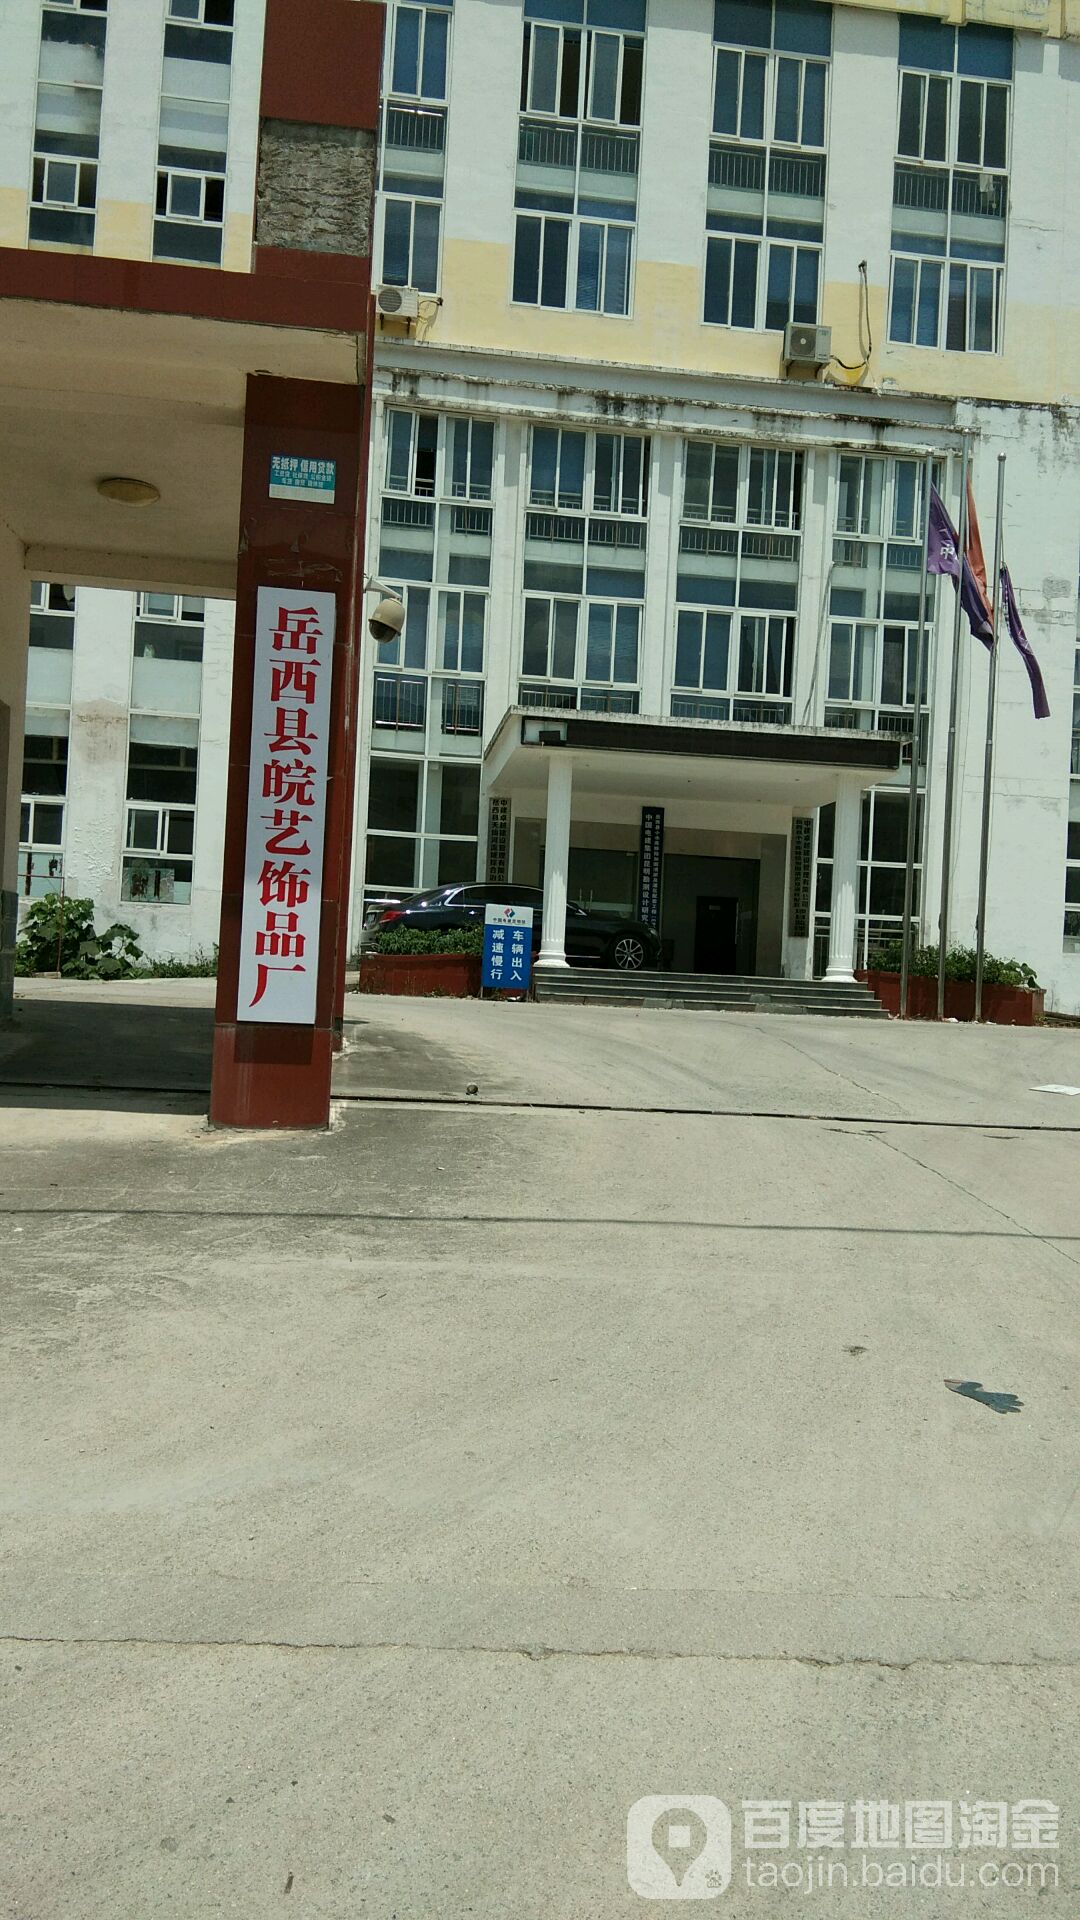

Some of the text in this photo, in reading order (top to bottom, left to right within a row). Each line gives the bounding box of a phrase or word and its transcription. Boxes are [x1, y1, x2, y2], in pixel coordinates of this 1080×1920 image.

[272, 456, 334, 475] 无抵押 信用贷款
[248, 606, 324, 1009] 岳西县皖艺饰品厂
[490, 928, 505, 980] 减速慢行
[510, 930, 525, 981] 车辆出入
